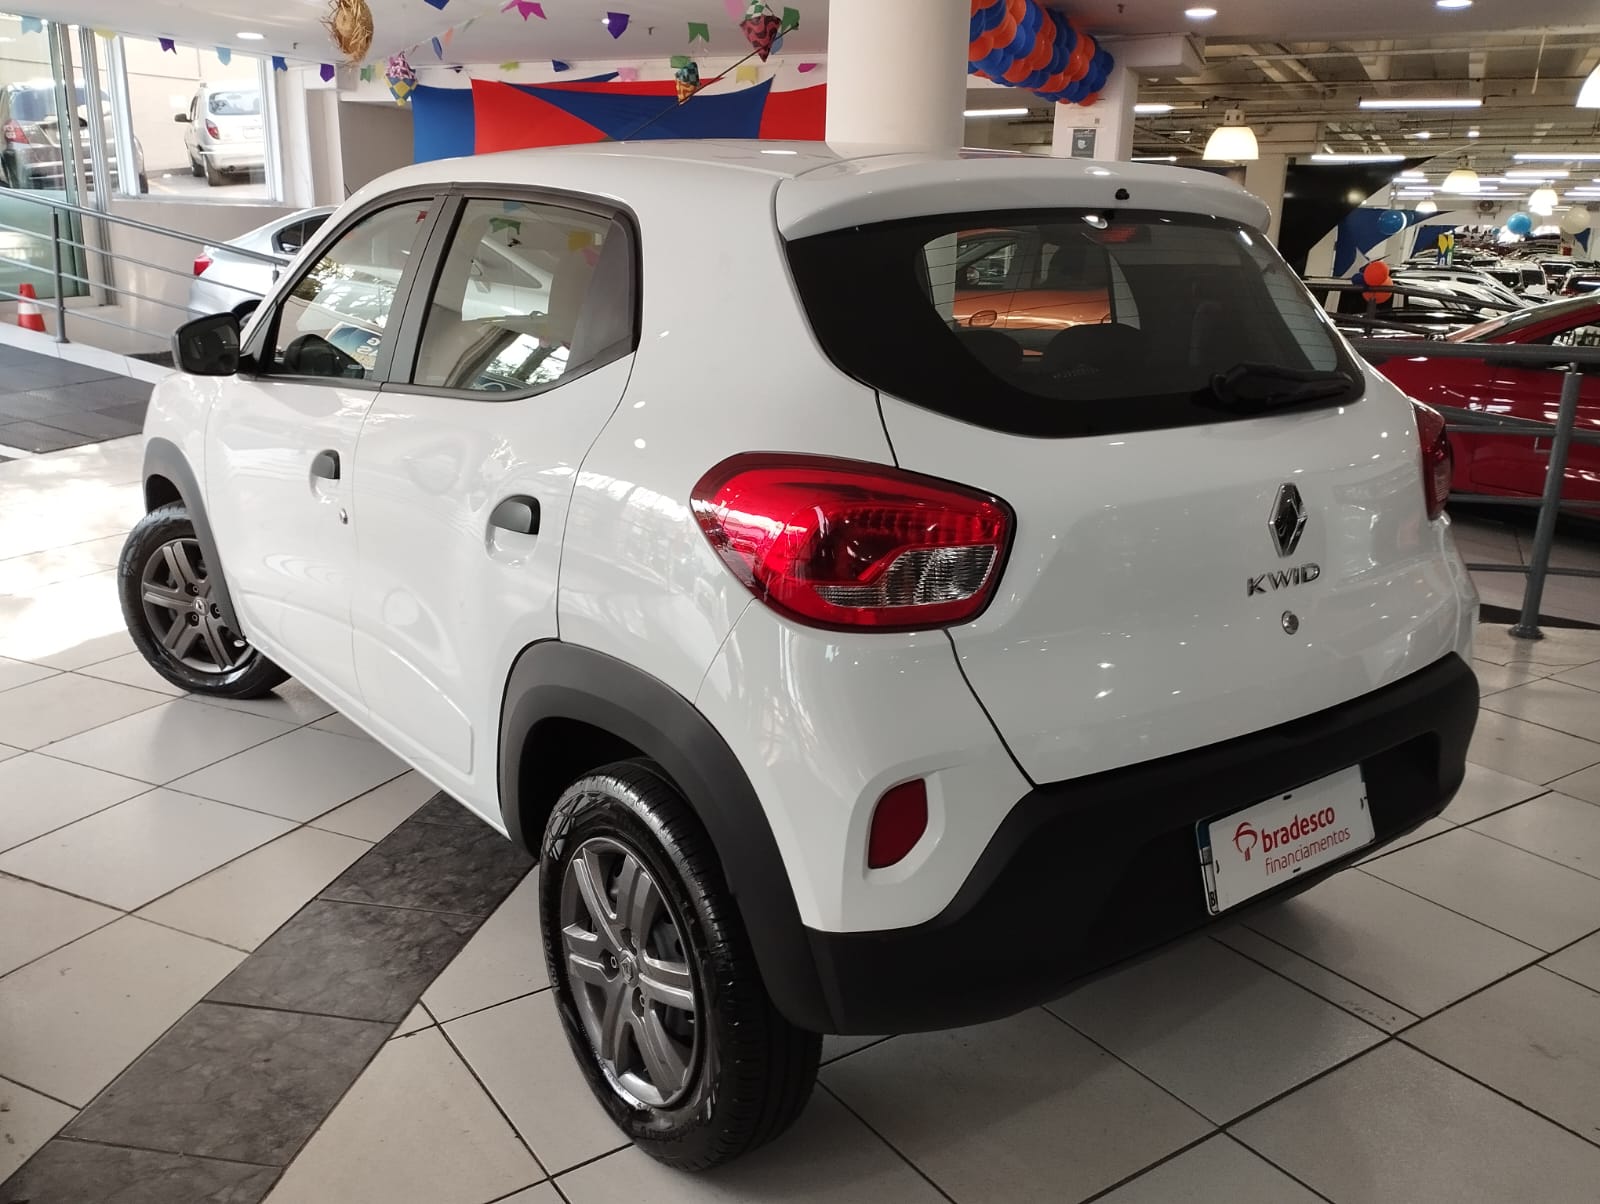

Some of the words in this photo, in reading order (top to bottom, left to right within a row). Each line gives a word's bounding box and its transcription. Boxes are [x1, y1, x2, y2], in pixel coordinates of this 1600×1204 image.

[1247, 562, 1320, 597] KWID
[1261, 807, 1335, 852] bradesco
[1265, 827, 1351, 876] financiamentos
